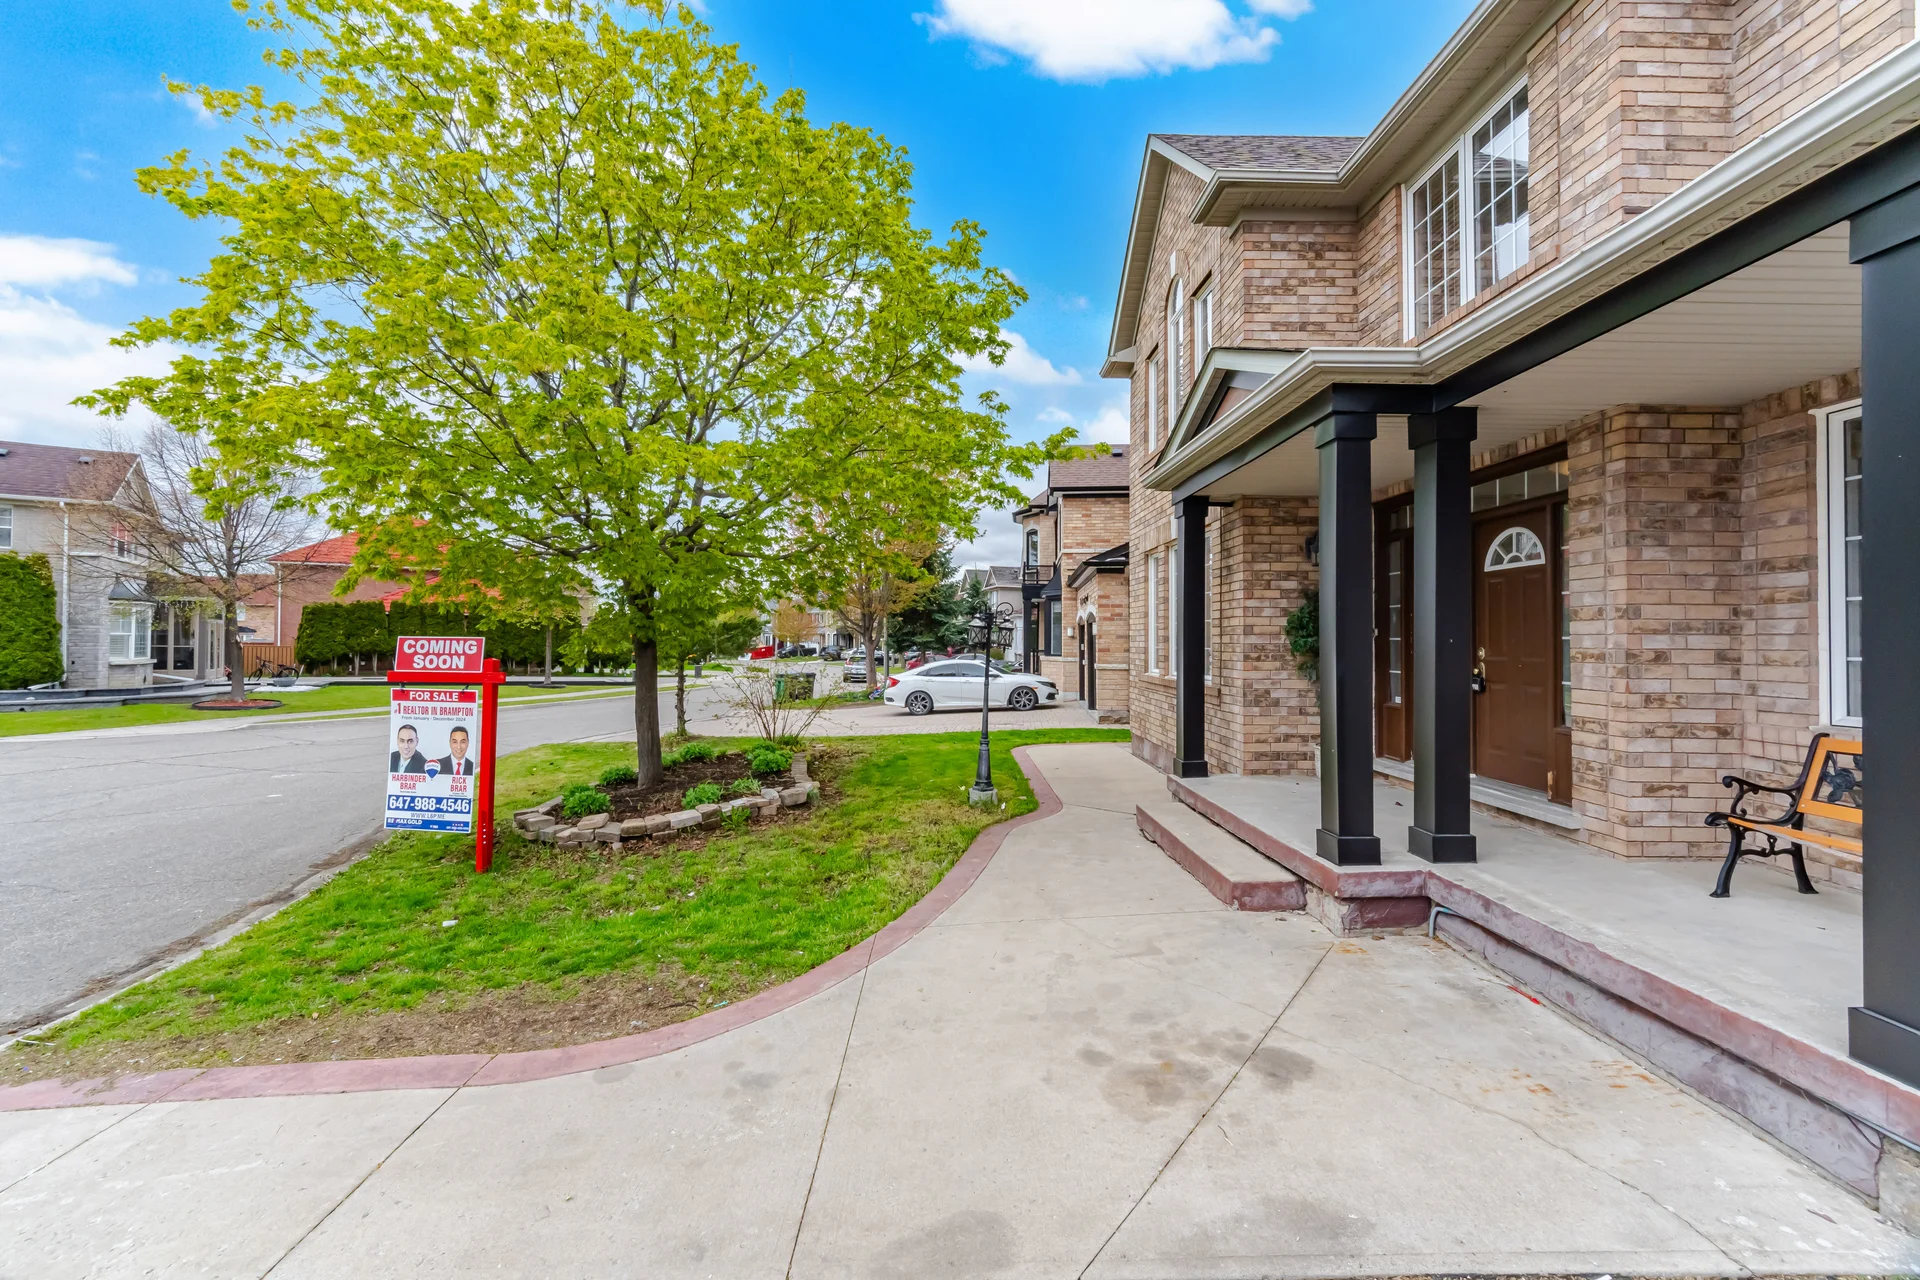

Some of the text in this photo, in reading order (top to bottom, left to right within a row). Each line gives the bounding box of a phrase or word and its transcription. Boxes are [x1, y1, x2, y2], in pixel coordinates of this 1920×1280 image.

[403, 640, 477, 654] COMING
[412, 655, 465, 669] SOON
[409, 691, 459, 702] FOR SALE
[403, 705, 429, 715] REALTOR
[431, 706, 437, 715] IN
[440, 707, 474, 716] BRAMPTON
[391, 774, 426, 782] HARBINDER
[400, 782, 417, 790] BRAR
[389, 796, 469, 812] 647-988-4546
